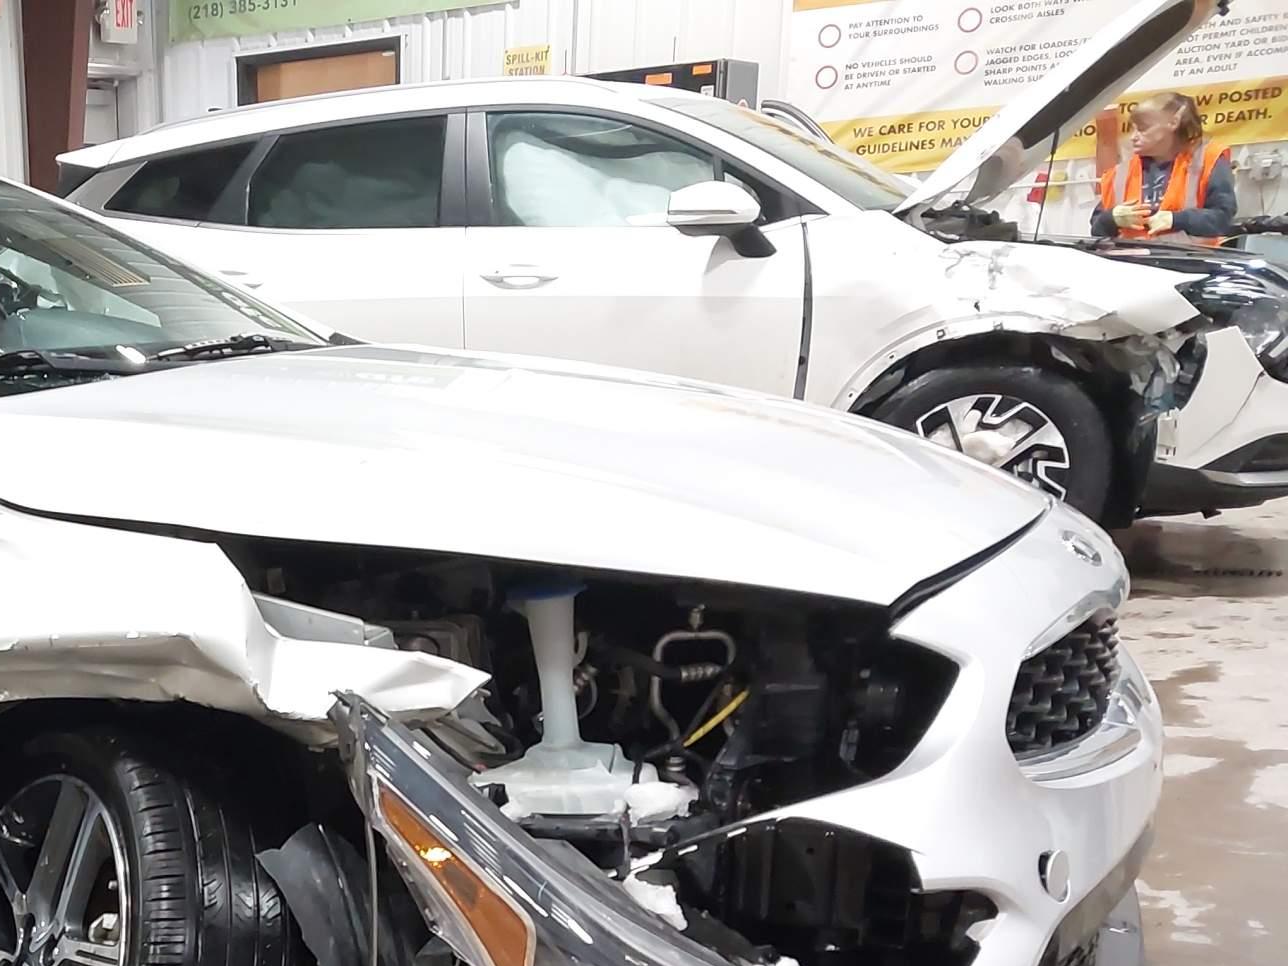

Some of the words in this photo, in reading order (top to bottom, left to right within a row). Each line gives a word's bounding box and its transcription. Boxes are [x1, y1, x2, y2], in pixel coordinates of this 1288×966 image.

[115, 0, 133, 28] EXIT
[188, 4, 224, 20] (218)
[990, 5, 1014, 14] LOOK
[1018, 1, 1041, 11] BOTH
[866, 16, 911, 27] ATTENTION
[913, 14, 924, 22] TO
[989, 13, 1034, 24] CROSSING
[1036, 8, 1065, 18] AISLES
[1219, 18, 1241, 27] AND
[1245, 12, 1279, 23] SAFETY
[872, 24, 939, 37] SURROUNDINGS
[1202, 29, 1237, 40] PERMIT
[986, 46, 1017, 55] WATCH
[1019, 43, 1036, 52] FOR
[1177, 43, 1221, 54] AUCTION
[1224, 38, 1250, 49] YARD
[1253, 37, 1268, 45] OR
[505, 50, 548, 66] SPILL-KIT
[845, 62, 859, 70] NO
[861, 58, 897, 69] VEHICLES
[900, 55, 933, 65] SHOULD
[985, 56, 1019, 66] JAGGED
[1206, 52, 1232, 62] EVEN
[1234, 50, 1243, 59] IF
[508, 65, 546, 76] STATION
[856, 70, 886, 79] DRIVEN
[888, 68, 900, 76] OR
[903, 65, 937, 75] STARTED
[984, 67, 1013, 77] SHARP
[1016, 63, 1047, 73] POINTS
[1173, 69, 1186, 77] BY
[1188, 67, 1204, 75] AN
[1206, 62, 1238, 73] ADULT
[844, 83, 854, 91] AT
[856, 79, 891, 89] ANYTIME
[983, 75, 1025, 87] WALKING
[853, 126, 874, 139] WE
[878, 122, 913, 136] CARE
[918, 119, 946, 132] FOR
[1218, 86, 1283, 105] POSTED
[855, 138, 936, 156] GUIDELINES
[1214, 107, 1273, 125] DEATH.
